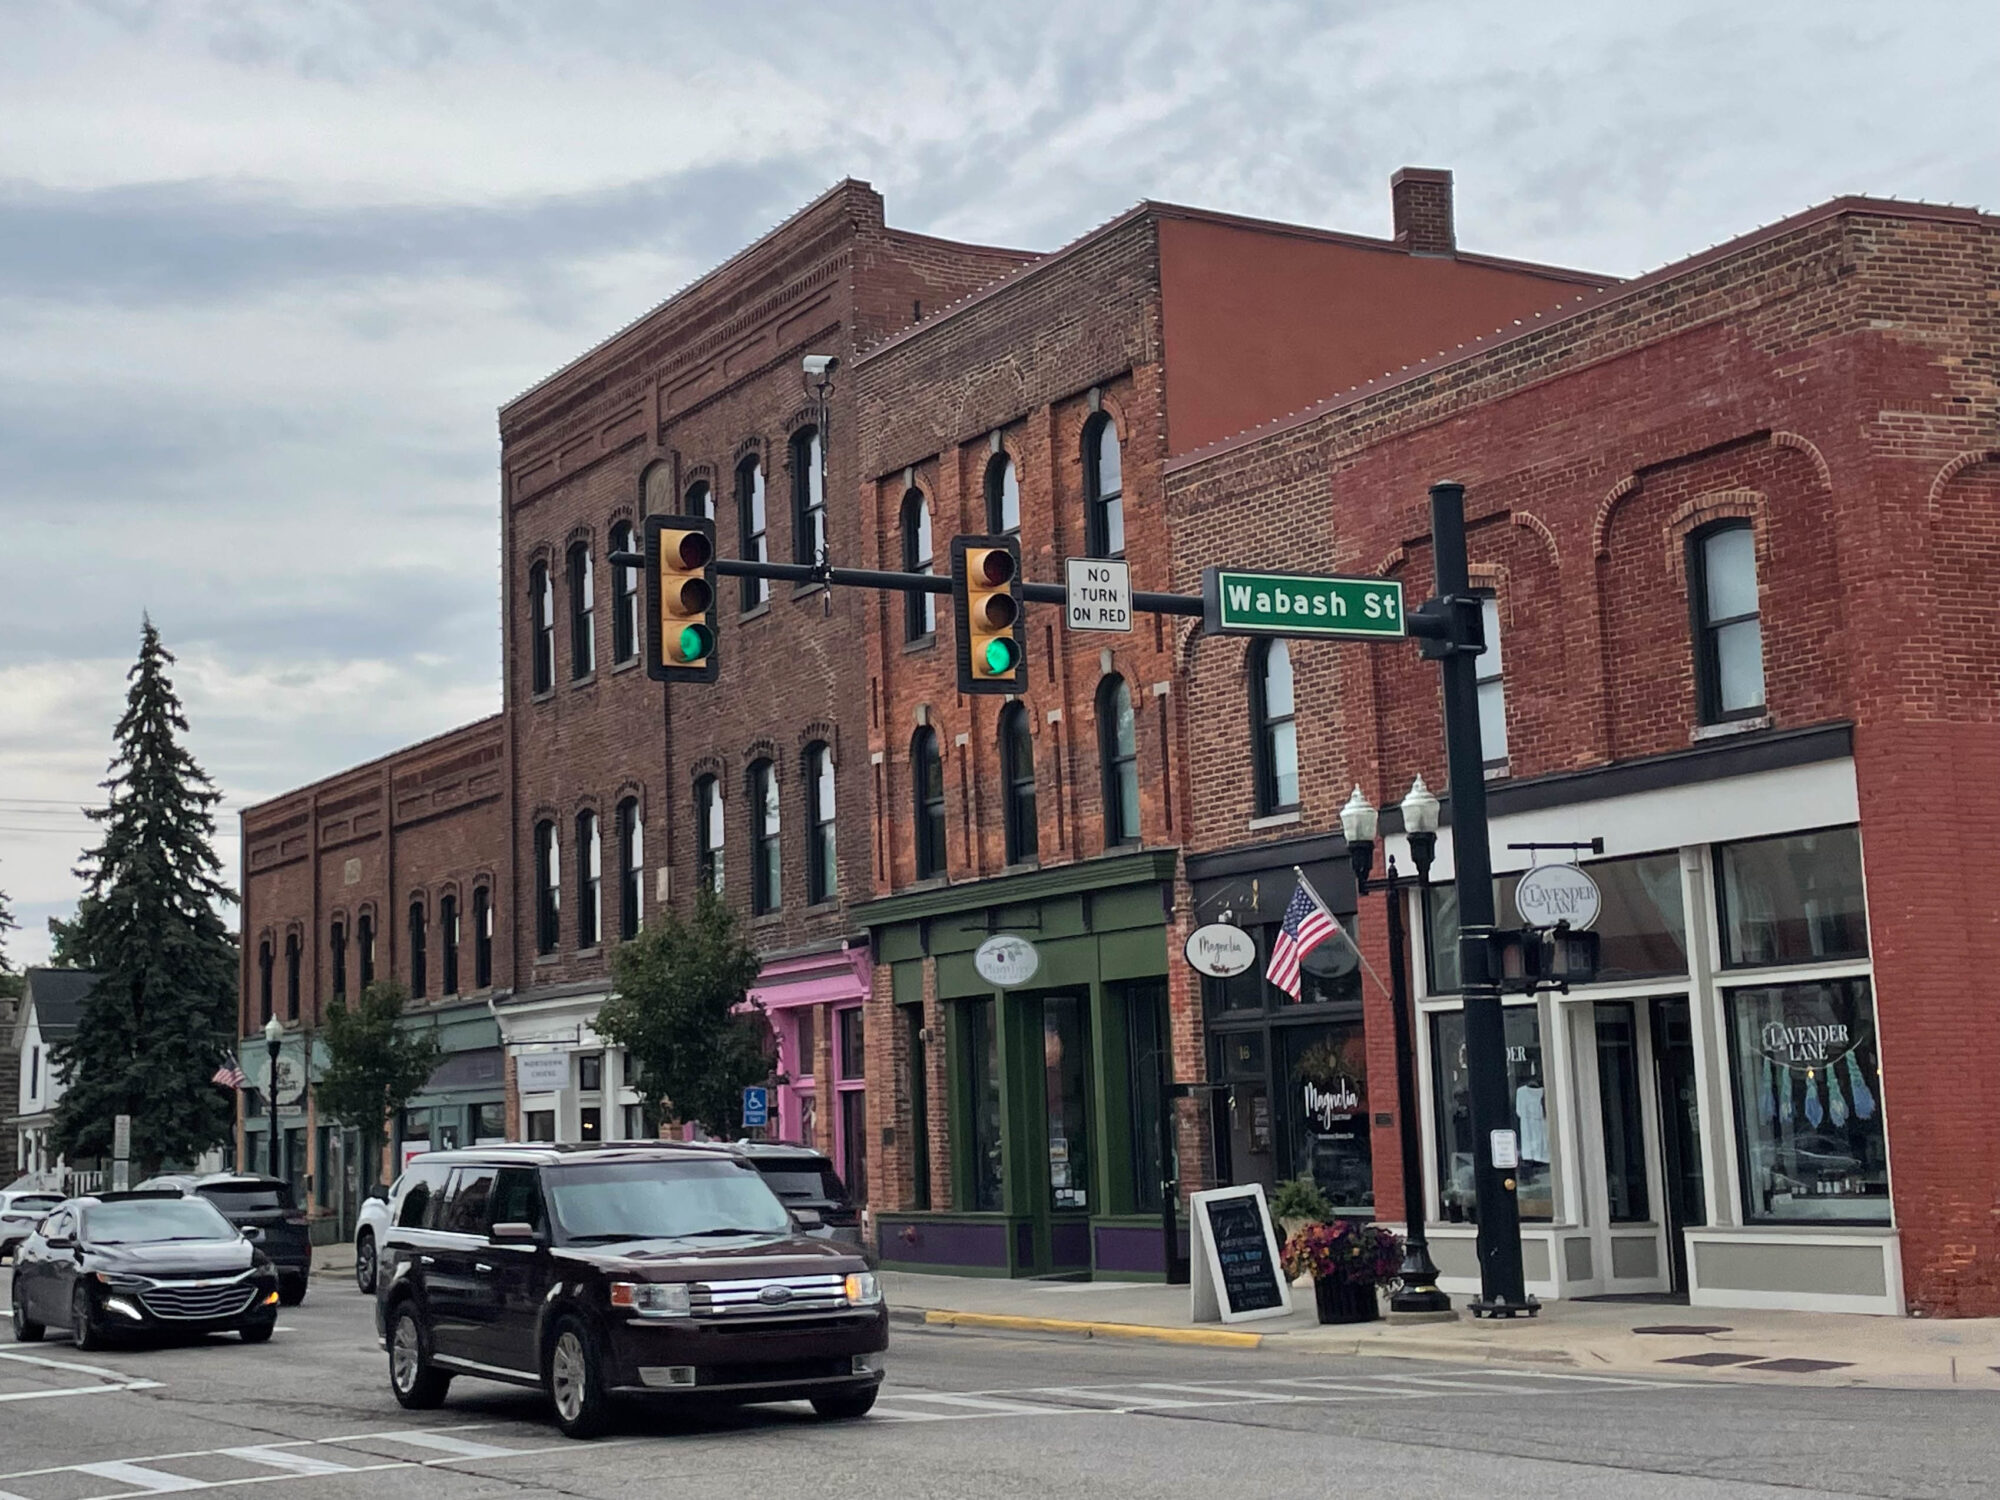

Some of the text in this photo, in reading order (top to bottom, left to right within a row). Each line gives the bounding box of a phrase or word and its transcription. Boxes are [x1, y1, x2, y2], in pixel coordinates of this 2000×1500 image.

[1088, 568, 1110, 582] NO
[1081, 587, 1117, 602] TURN
[1228, 585, 1396, 620] Wabash St
[1073, 607, 1126, 622] ON RED
[1529, 886, 1595, 903] LAVENDER
[1546, 901, 1580, 915] LANE
[1199, 935, 1242, 963] Magnolia
[1770, 1024, 1849, 1046] LAVENDER
[1789, 1043, 1829, 1061] LANE
[1304, 1078, 1359, 1131] Magnolia
